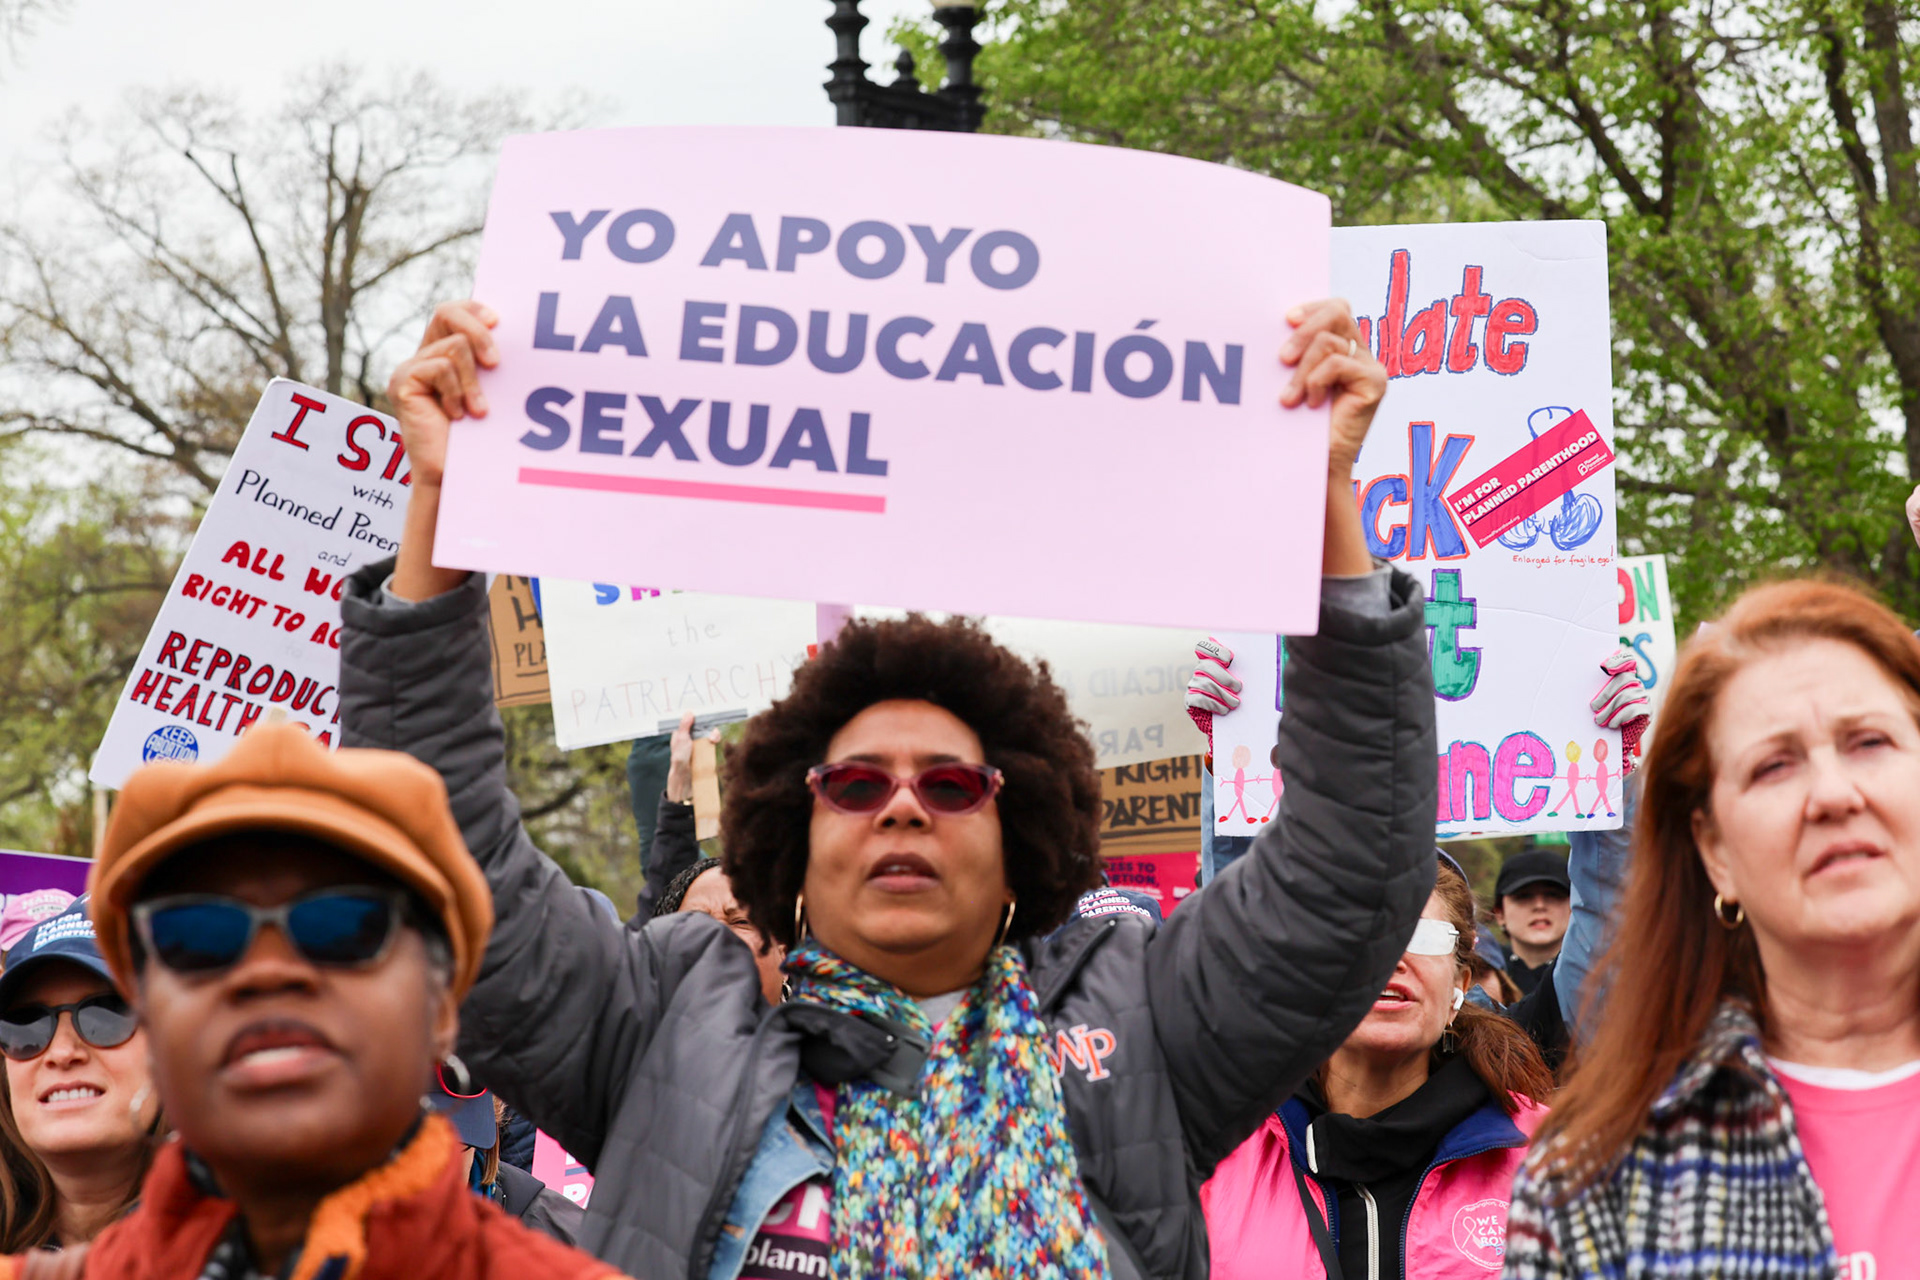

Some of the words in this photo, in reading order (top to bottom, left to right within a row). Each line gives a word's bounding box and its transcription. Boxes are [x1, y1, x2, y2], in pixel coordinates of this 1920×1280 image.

[548, 208, 676, 264] YO
[699, 212, 1040, 290] APOYO
[532, 292, 649, 358] LA
[679, 300, 1244, 405] EDUCACIÓN
[271, 392, 327, 451] I
[518, 385, 889, 476] SEXUAL
[1352, 421, 1476, 561] ck
[1462, 484, 1518, 525] PLANNED
[1517, 431, 1598, 488] PARENTHOOD
[235, 469, 343, 530] Planned
[353, 485, 394, 509] with
[1453, 493, 1476, 512] I'M
[1474, 477, 1501, 499] FOR
[221, 540, 285, 581] ALL
[318, 549, 352, 568] and
[1512, 555, 1550, 569] Enlarged
[1554, 555, 1566, 565] for
[1569, 555, 1595, 567] fragile
[182, 573, 267, 619] RIGHT
[272, 605, 305, 632] TO
[667, 615, 721, 647] the
[131, 668, 263, 736] HEALTH
[160, 727, 195, 747] KEEP
[1138, 863, 1155, 873] TO
[1079, 896, 1131, 912] PLANNED
[1095, 889, 1118, 899] FOR
[35, 920, 93, 942] PLANNED
[57, 912, 82, 924] FOR
[1476, 1215, 1499, 1226] WE
[1478, 1226, 1506, 1236] CAN
